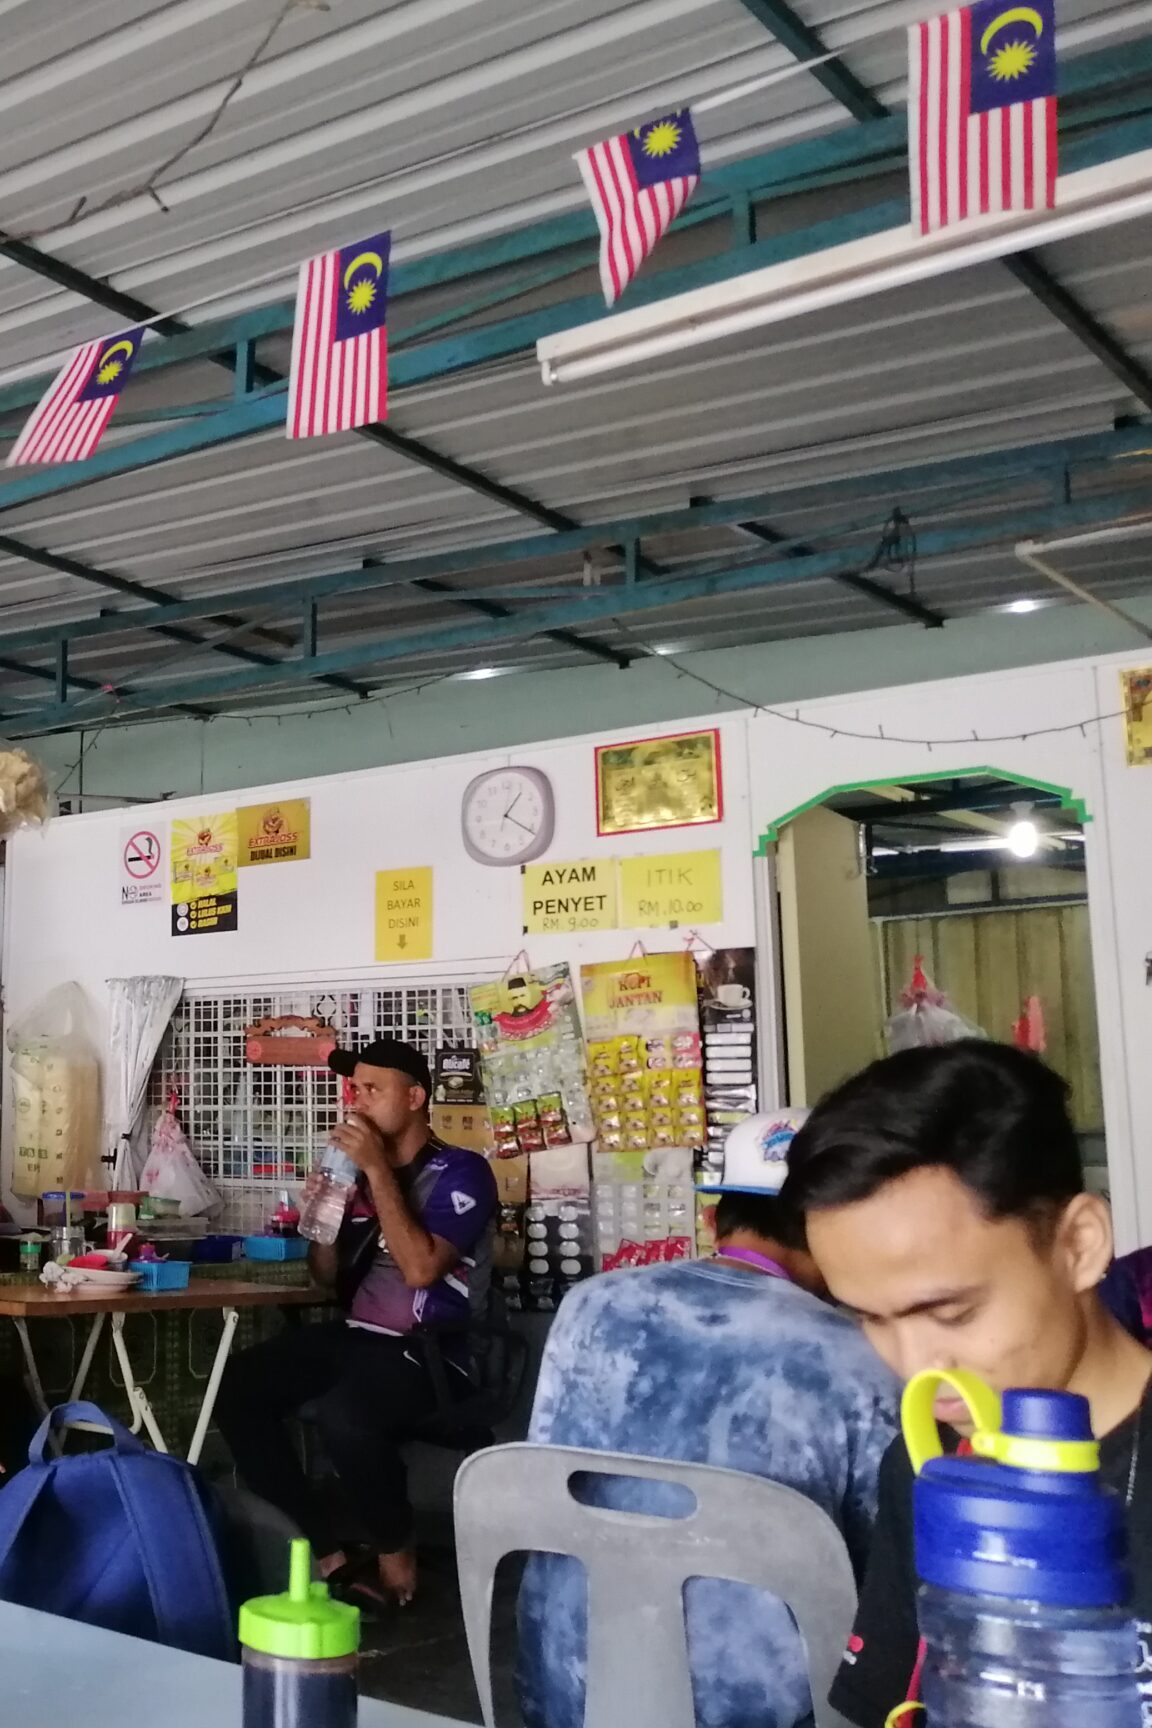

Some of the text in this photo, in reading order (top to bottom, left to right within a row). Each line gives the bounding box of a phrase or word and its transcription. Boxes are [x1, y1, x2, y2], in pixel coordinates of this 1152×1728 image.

[541, 866, 597, 886] AYAM
[647, 867, 694, 888] ITIK
[393, 879, 415, 891] SILA
[387, 897, 421, 911] BAYAR
[533, 894, 607, 916] PENYET
[388, 916, 419, 929] DISINI
